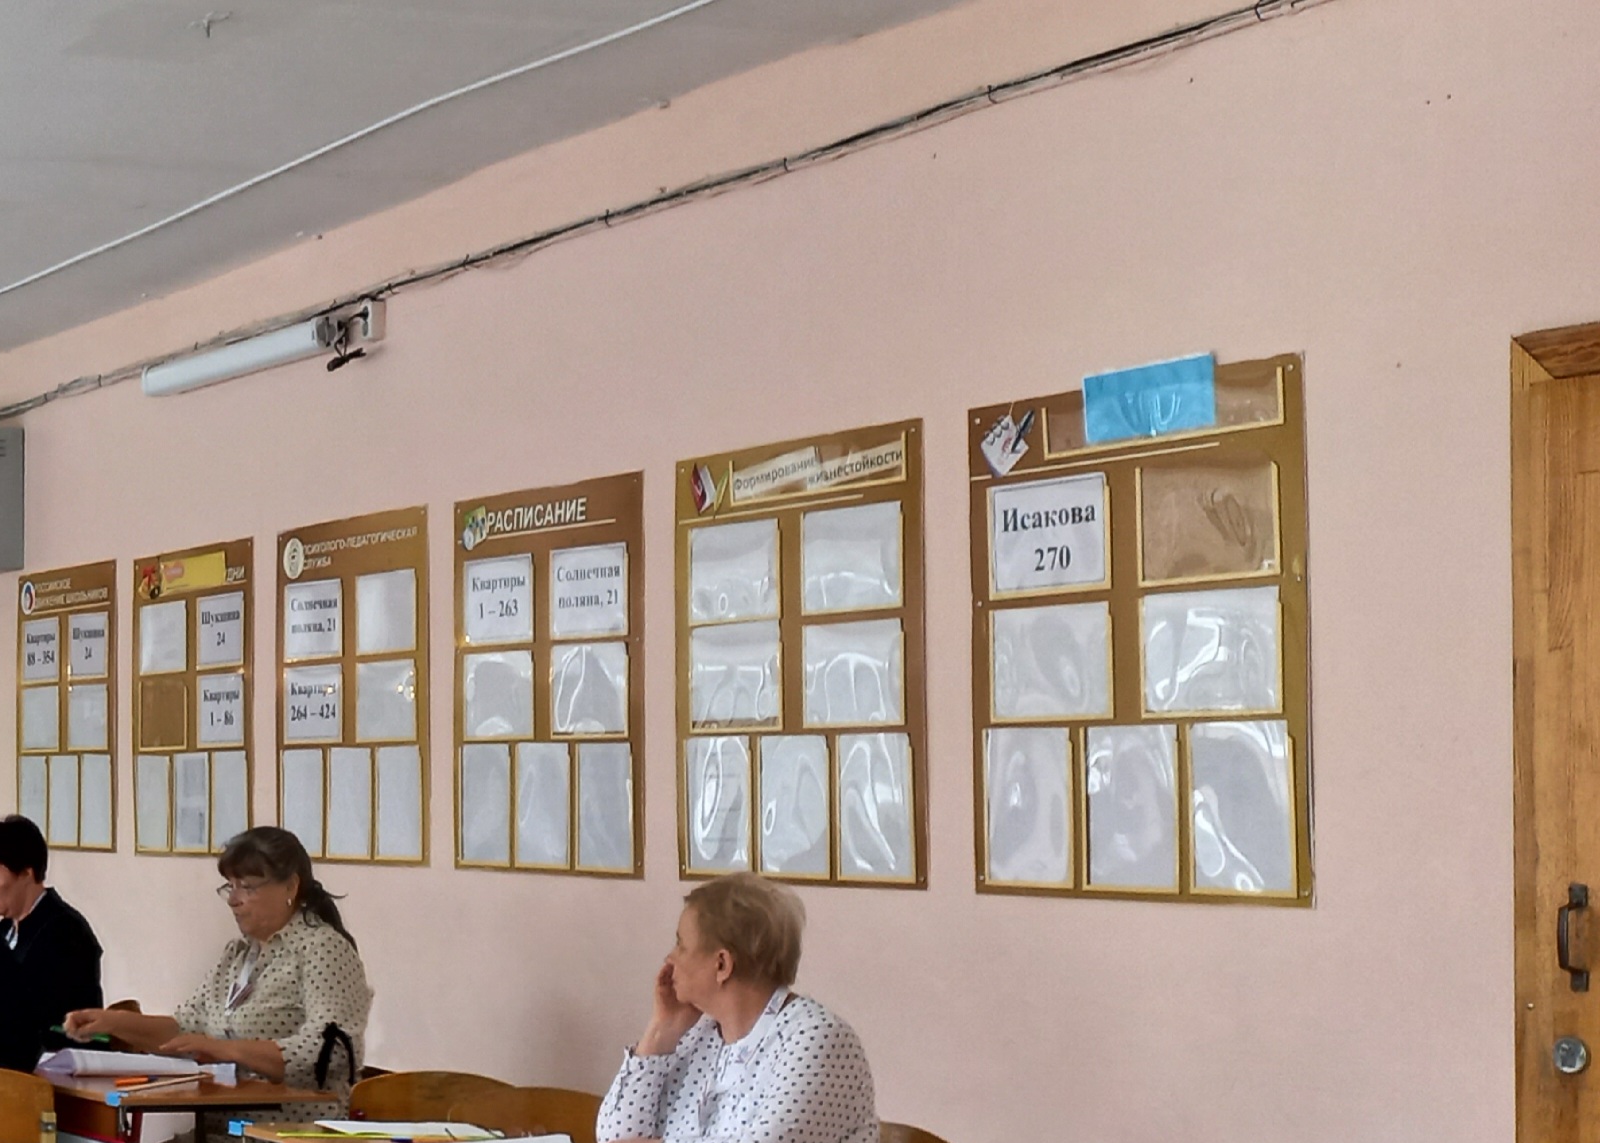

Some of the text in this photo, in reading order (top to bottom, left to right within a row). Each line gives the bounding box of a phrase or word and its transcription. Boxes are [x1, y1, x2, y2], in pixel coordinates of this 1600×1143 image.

[487, 498, 587, 533] РАСПИСАНИЕ
[1002, 504, 1096, 533] Исакова
[1033, 545, 1071, 572] 270
[472, 575, 526, 593] Квартиры
[557, 565, 620, 583] Солнечная
[479, 603, 484, 619] 1
[499, 599, 518, 617] 263
[558, 589, 618, 609] поляна, 21
[291, 705, 307, 721] 264
[319, 703, 336, 719] 424
